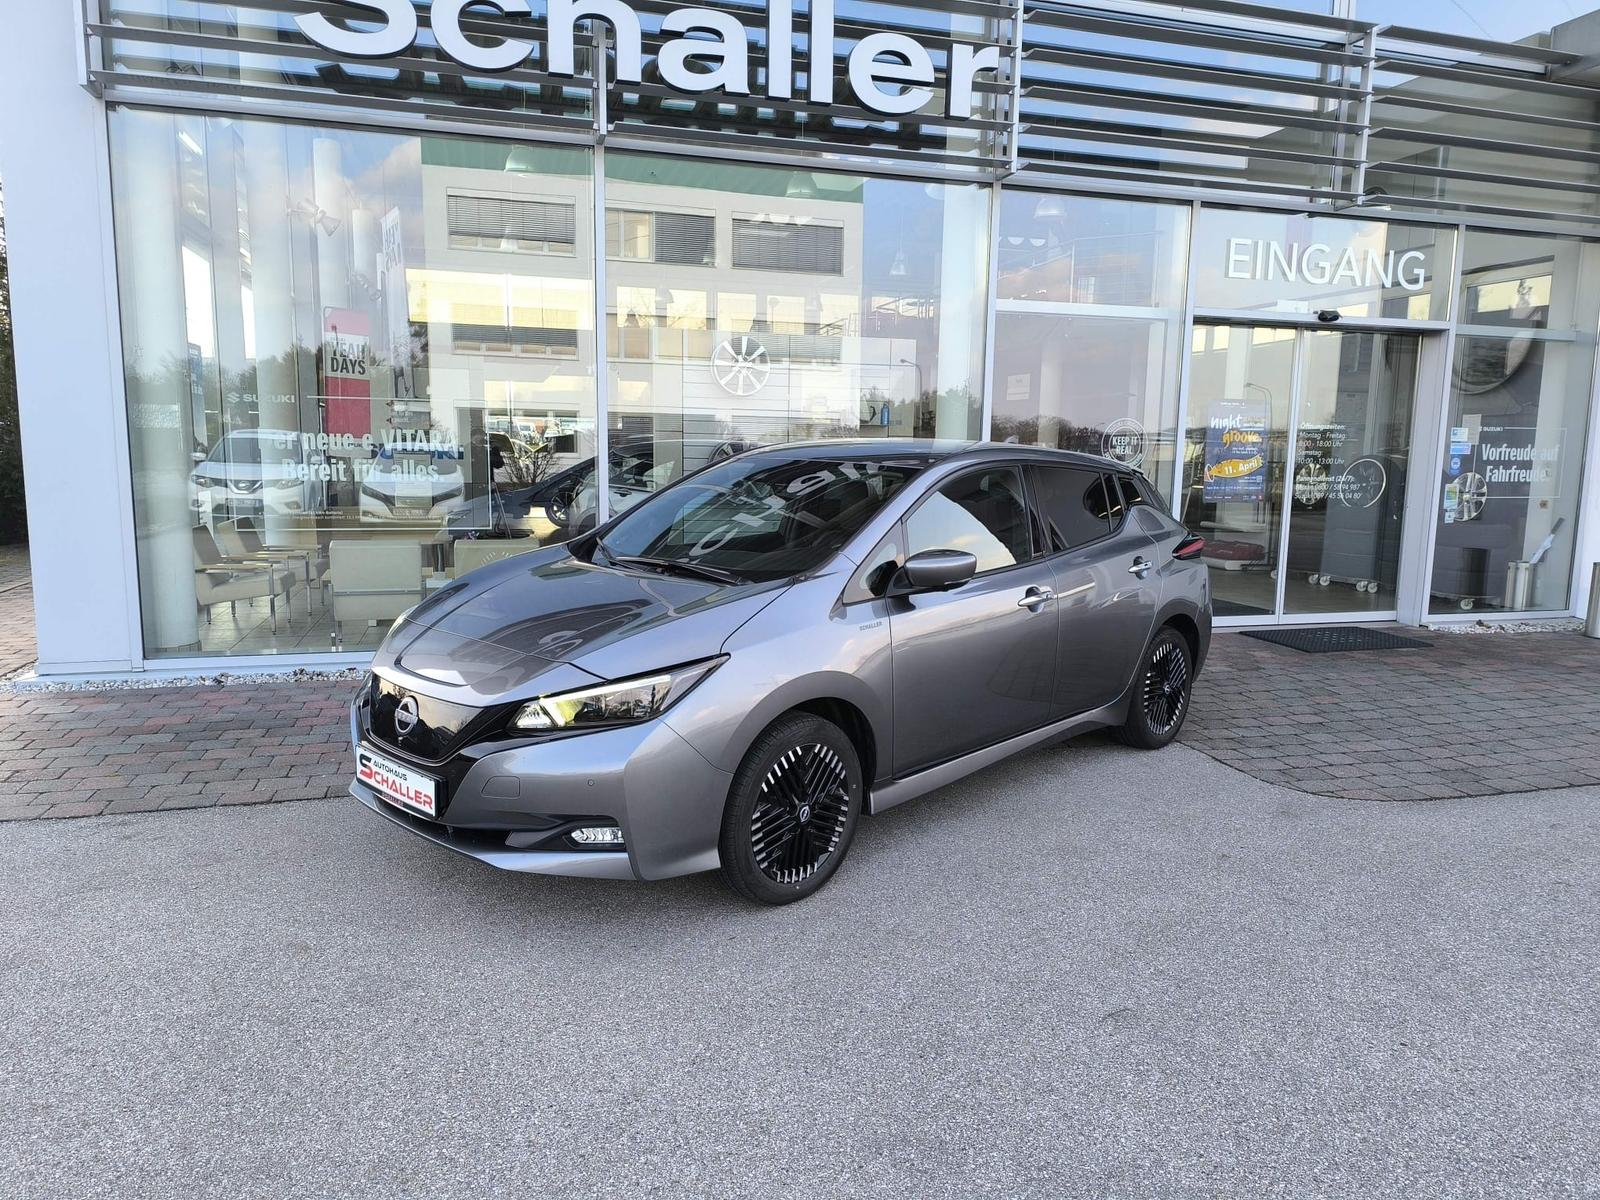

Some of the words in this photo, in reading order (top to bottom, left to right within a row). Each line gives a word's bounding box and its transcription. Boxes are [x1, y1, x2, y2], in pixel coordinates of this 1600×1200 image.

[1226, 237, 1426, 291] EINGANG
[331, 357, 366, 375] DAYS
[1210, 414, 1243, 433] night
[302, 431, 354, 450] neue
[1112, 436, 1130, 446] KEEP
[1131, 436, 1138, 446] IT
[1332, 439, 1343, 447] Uhr
[1116, 445, 1133, 455] REAL
[1481, 443, 1537, 461] Vorfreude
[281, 458, 347, 482] Bereit
[1225, 466, 1236, 474] 11.
[1238, 459, 1258, 472] April
[373, 757, 408, 782] AUTOHAUS
[360, 753, 433, 810] SCHALLER
